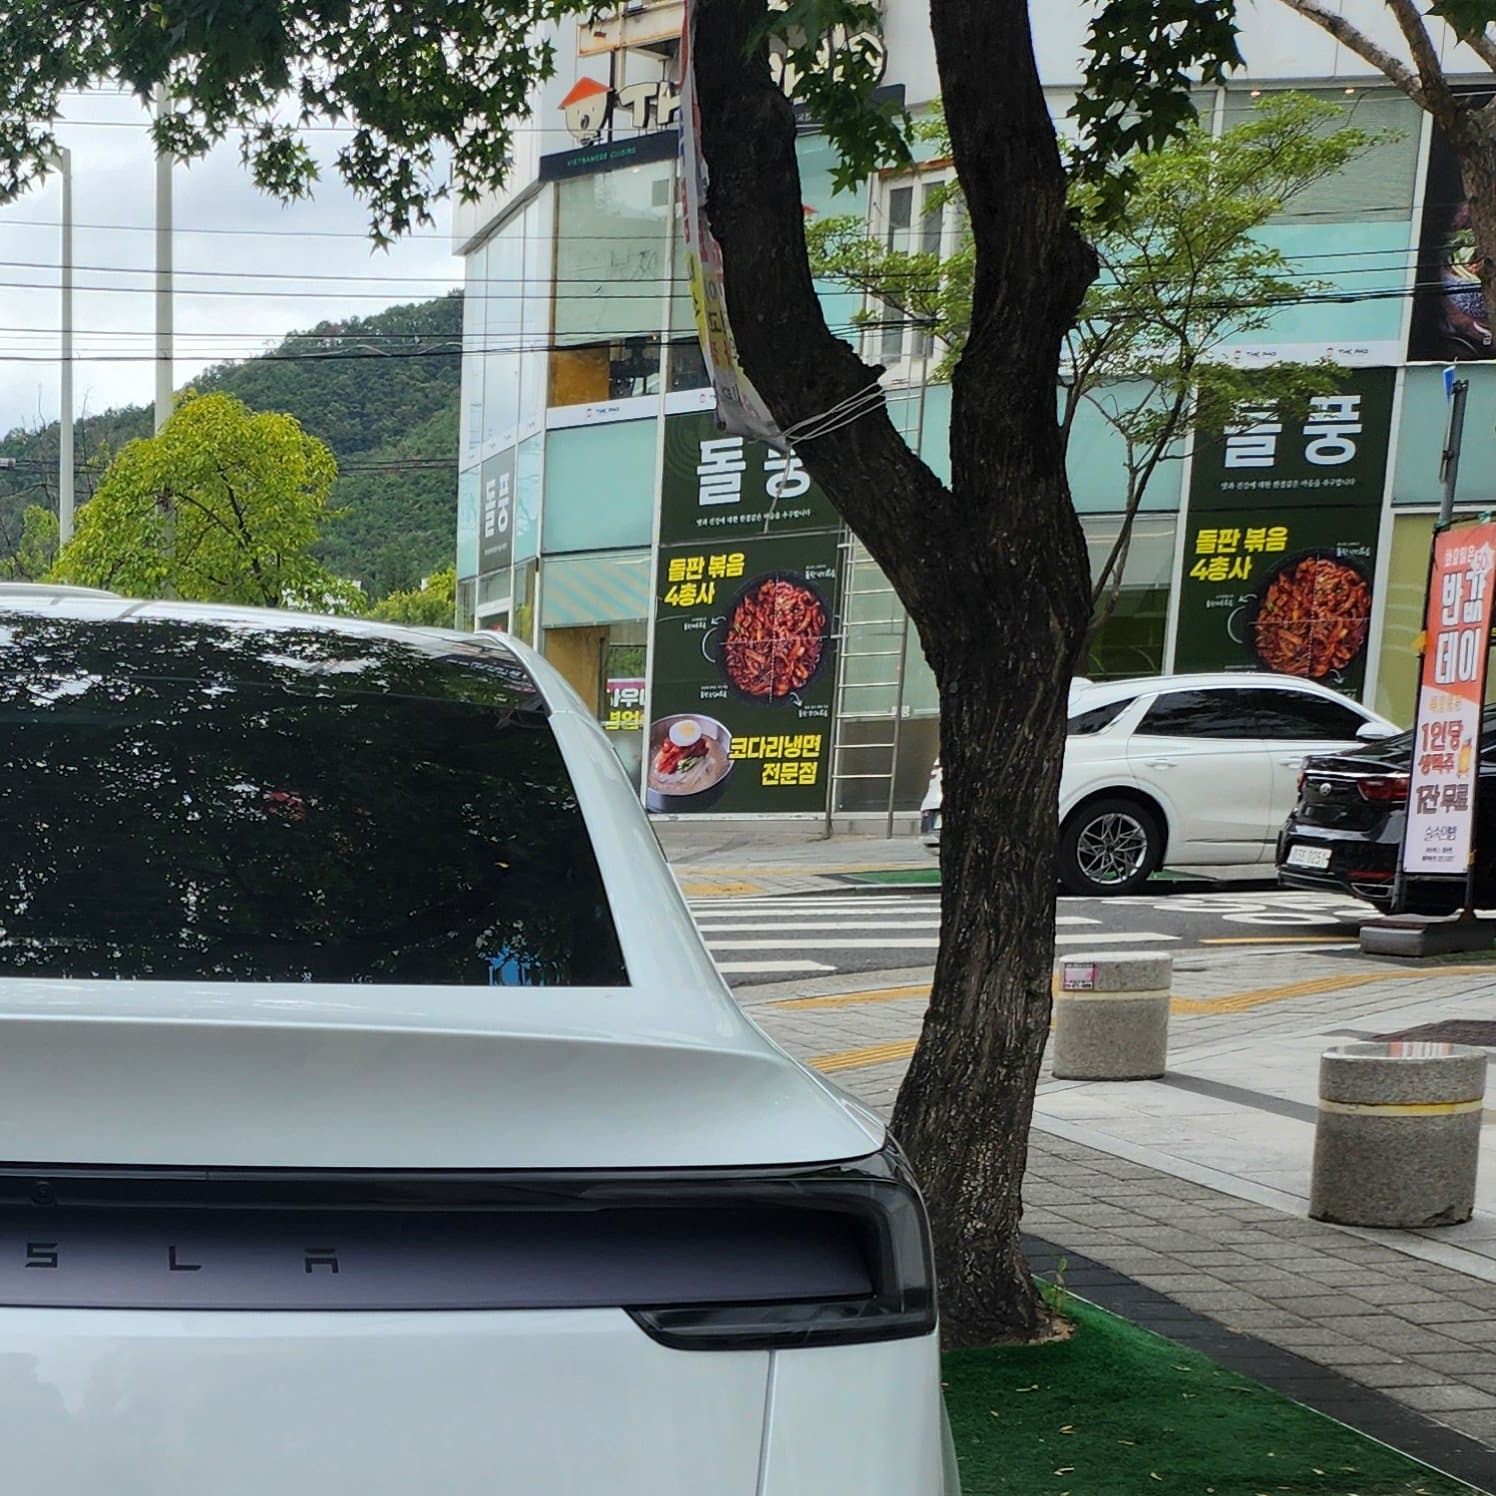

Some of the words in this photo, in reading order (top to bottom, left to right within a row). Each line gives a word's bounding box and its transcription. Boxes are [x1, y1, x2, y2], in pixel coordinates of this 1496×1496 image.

[1196, 528, 1241, 554] 돌판
[1244, 526, 1288, 552] 볶음
[668, 556, 705, 582] 돌판
[708, 553, 745, 579] 볶음
[1189, 556, 1252, 581] 4총사
[664, 581, 716, 607] 4총사
[1441, 569, 1487, 627] 반값
[1434, 628, 1481, 685] 데이
[728, 734, 822, 759] 코다리냉면
[1421, 720, 1464, 753] 1인당
[761, 761, 818, 786] 전문점
[1418, 752, 1455, 776] 생맥주
[1441, 783, 1469, 814] 무료
